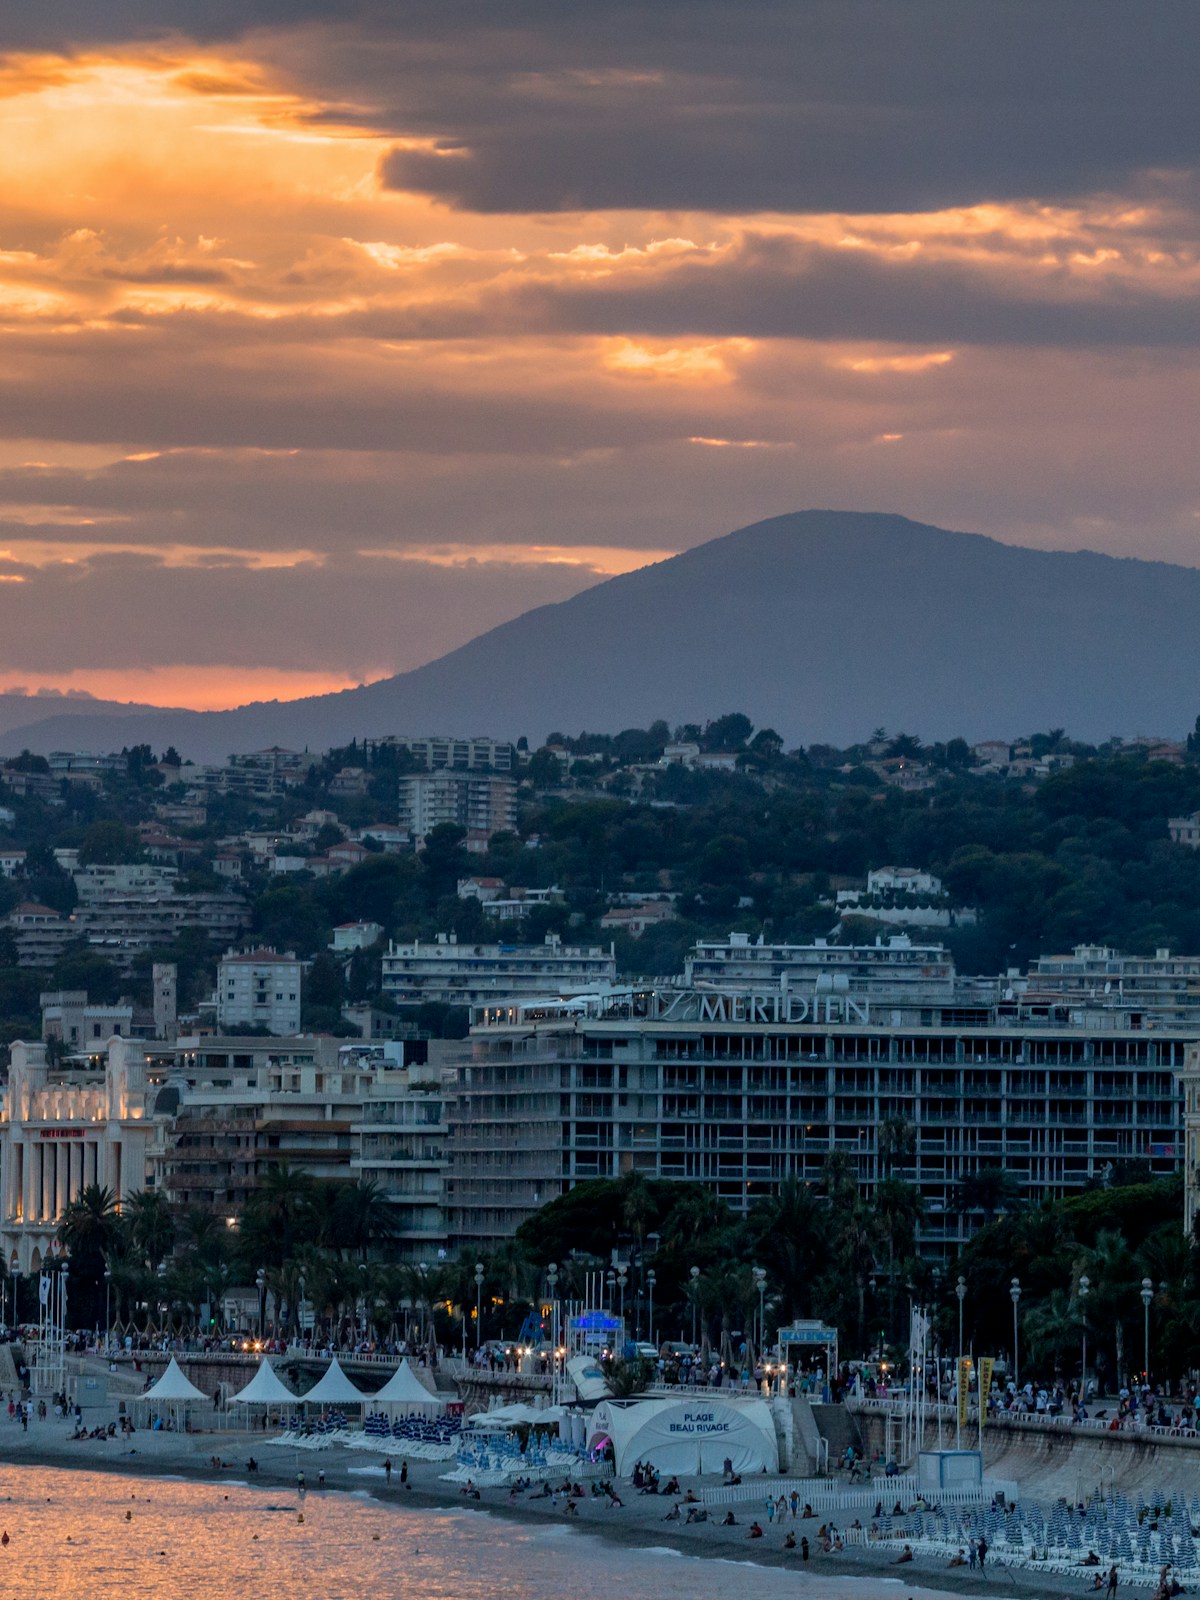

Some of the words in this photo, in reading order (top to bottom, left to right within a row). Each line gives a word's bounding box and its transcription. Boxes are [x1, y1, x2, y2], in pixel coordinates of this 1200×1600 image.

[699, 994, 870, 1025] MERIDIEN
[684, 1413, 714, 1422] PLAGE
[669, 1424, 695, 1432] BEAU
[696, 1423, 730, 1432] RIVAGE
